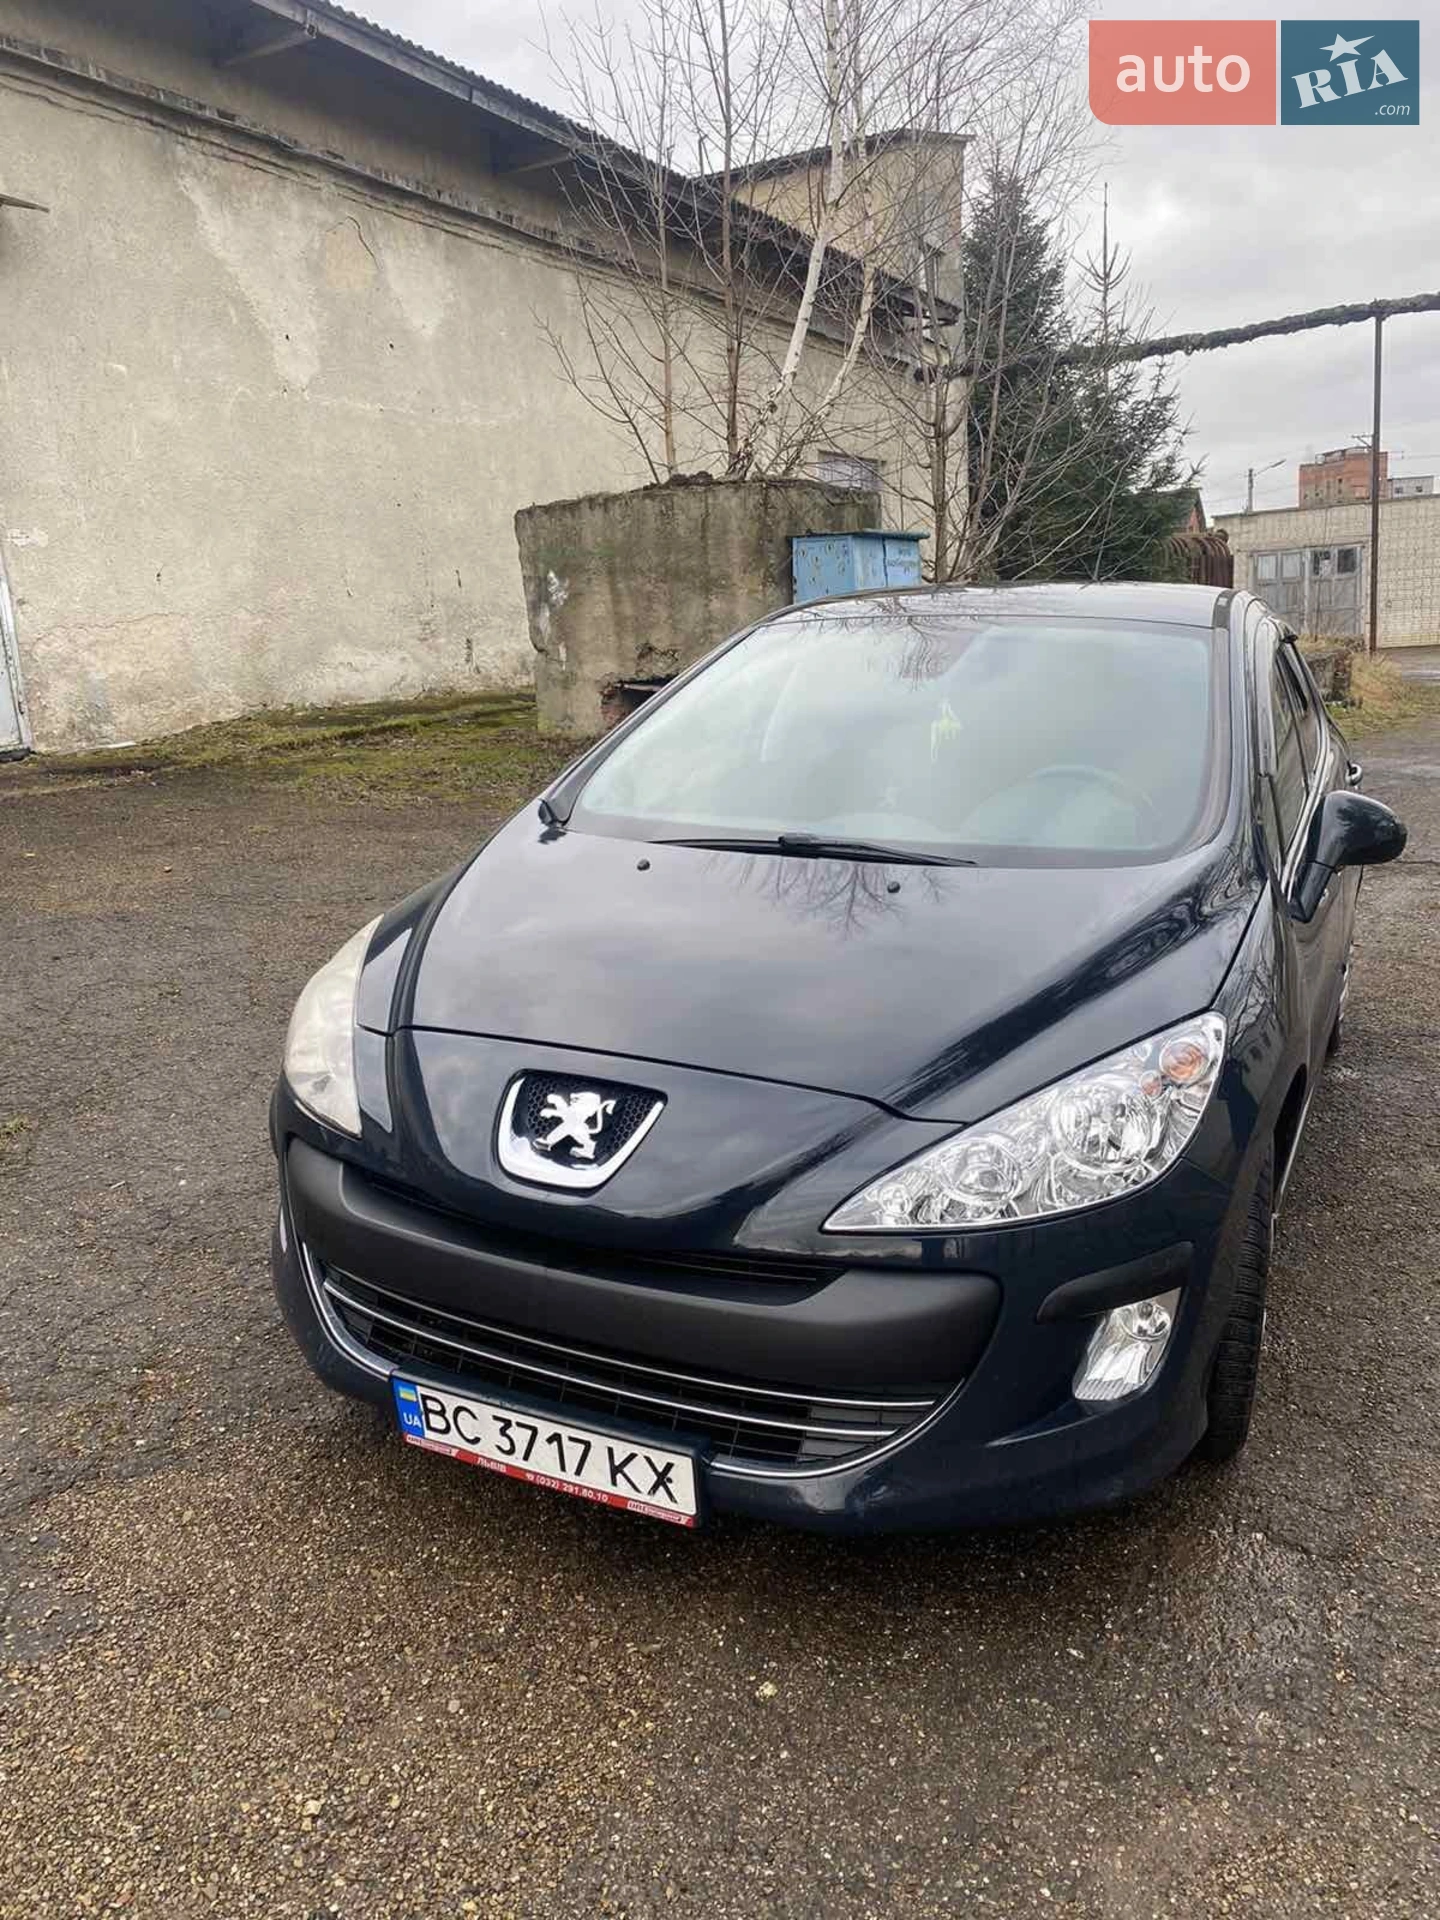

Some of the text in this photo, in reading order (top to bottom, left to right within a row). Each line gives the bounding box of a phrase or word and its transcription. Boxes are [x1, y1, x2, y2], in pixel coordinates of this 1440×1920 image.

[403, 1412, 421, 1428] UA
[420, 1394, 679, 1504] BC 3717 KX
